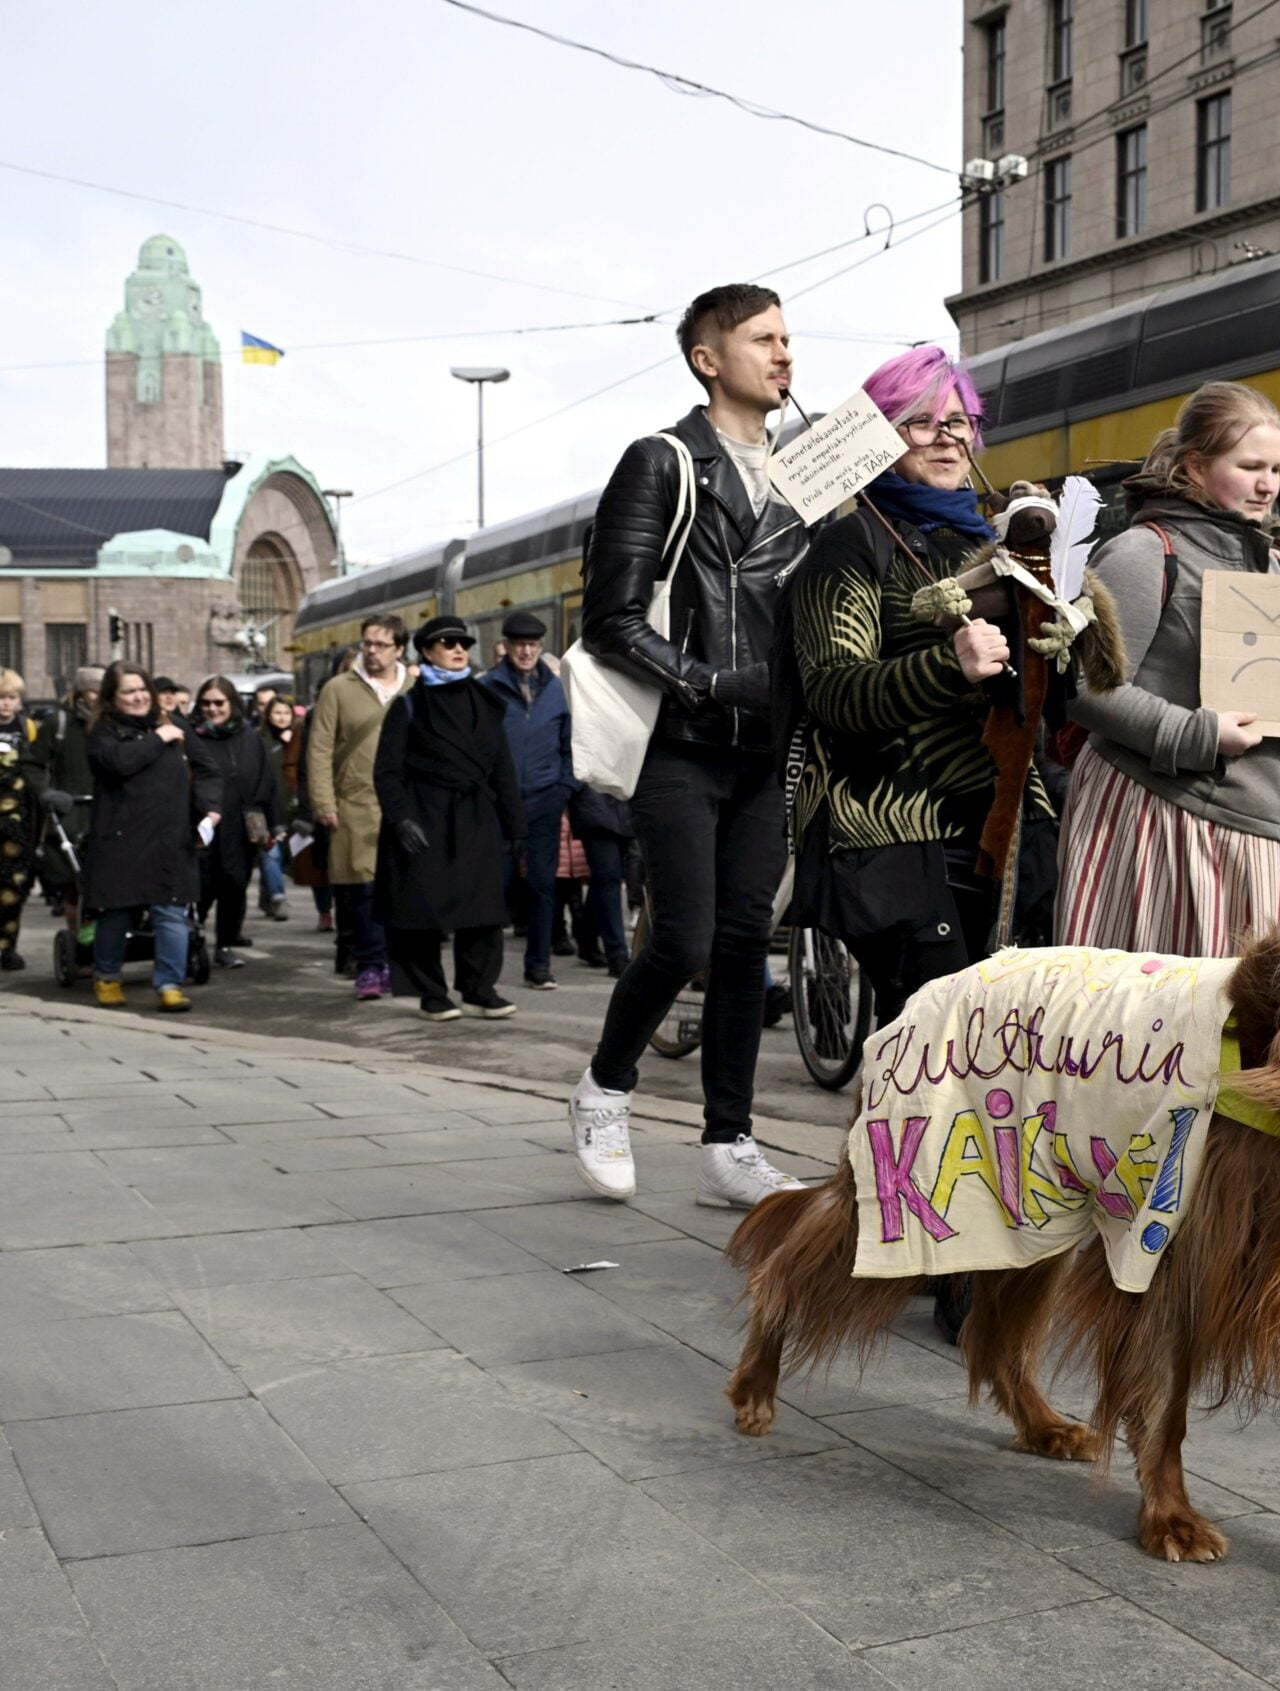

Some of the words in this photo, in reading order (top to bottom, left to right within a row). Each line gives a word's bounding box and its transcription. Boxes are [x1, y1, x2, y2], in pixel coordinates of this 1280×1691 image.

[778, 409, 860, 469] Tunnetaitokasvatusta
[788, 465, 808, 482] myös
[839, 469, 864, 495] ÄLÄ
